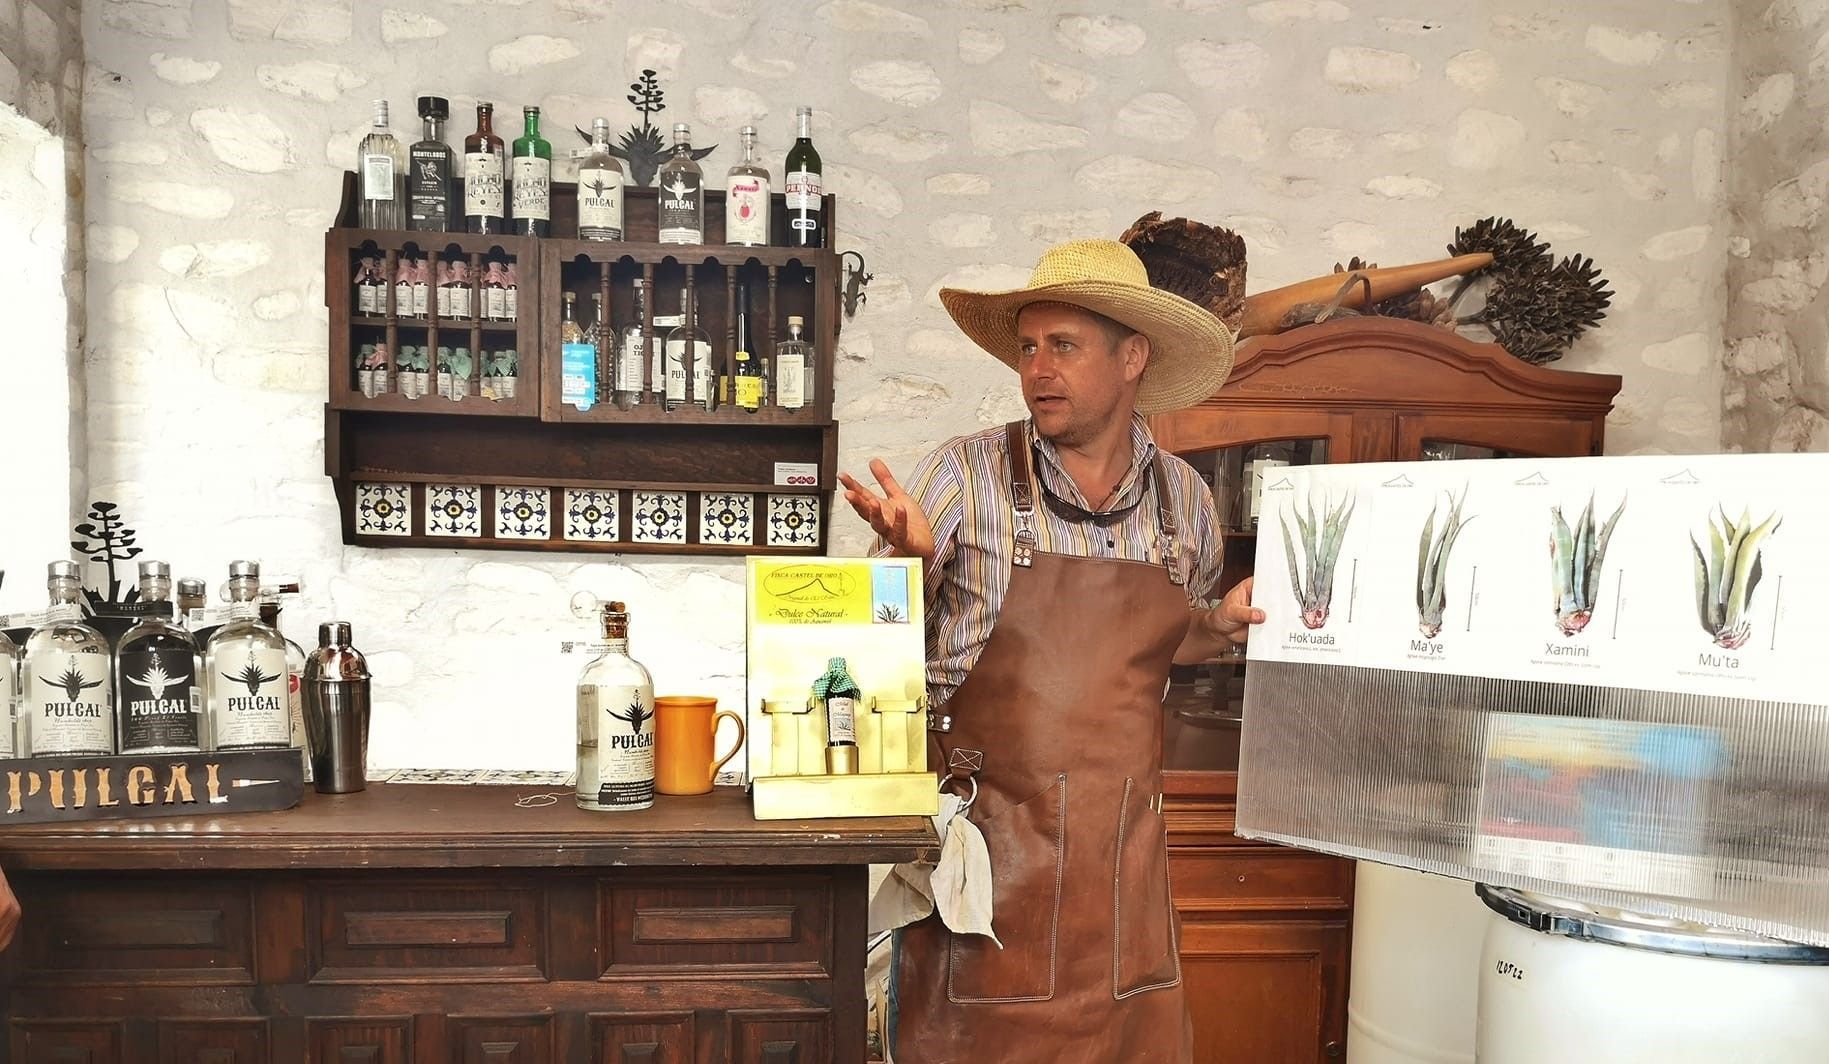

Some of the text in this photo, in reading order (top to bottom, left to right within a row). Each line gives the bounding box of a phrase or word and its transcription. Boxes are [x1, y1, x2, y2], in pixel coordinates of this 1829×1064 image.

[775, 608, 845, 618] Dulce Natural
[1289, 632, 1335, 645] Hok'uada
[1410, 640, 1444, 655] Ma'ye
[1545, 642, 1590, 657] Xamini
[1698, 653, 1739, 669] Mu'ta
